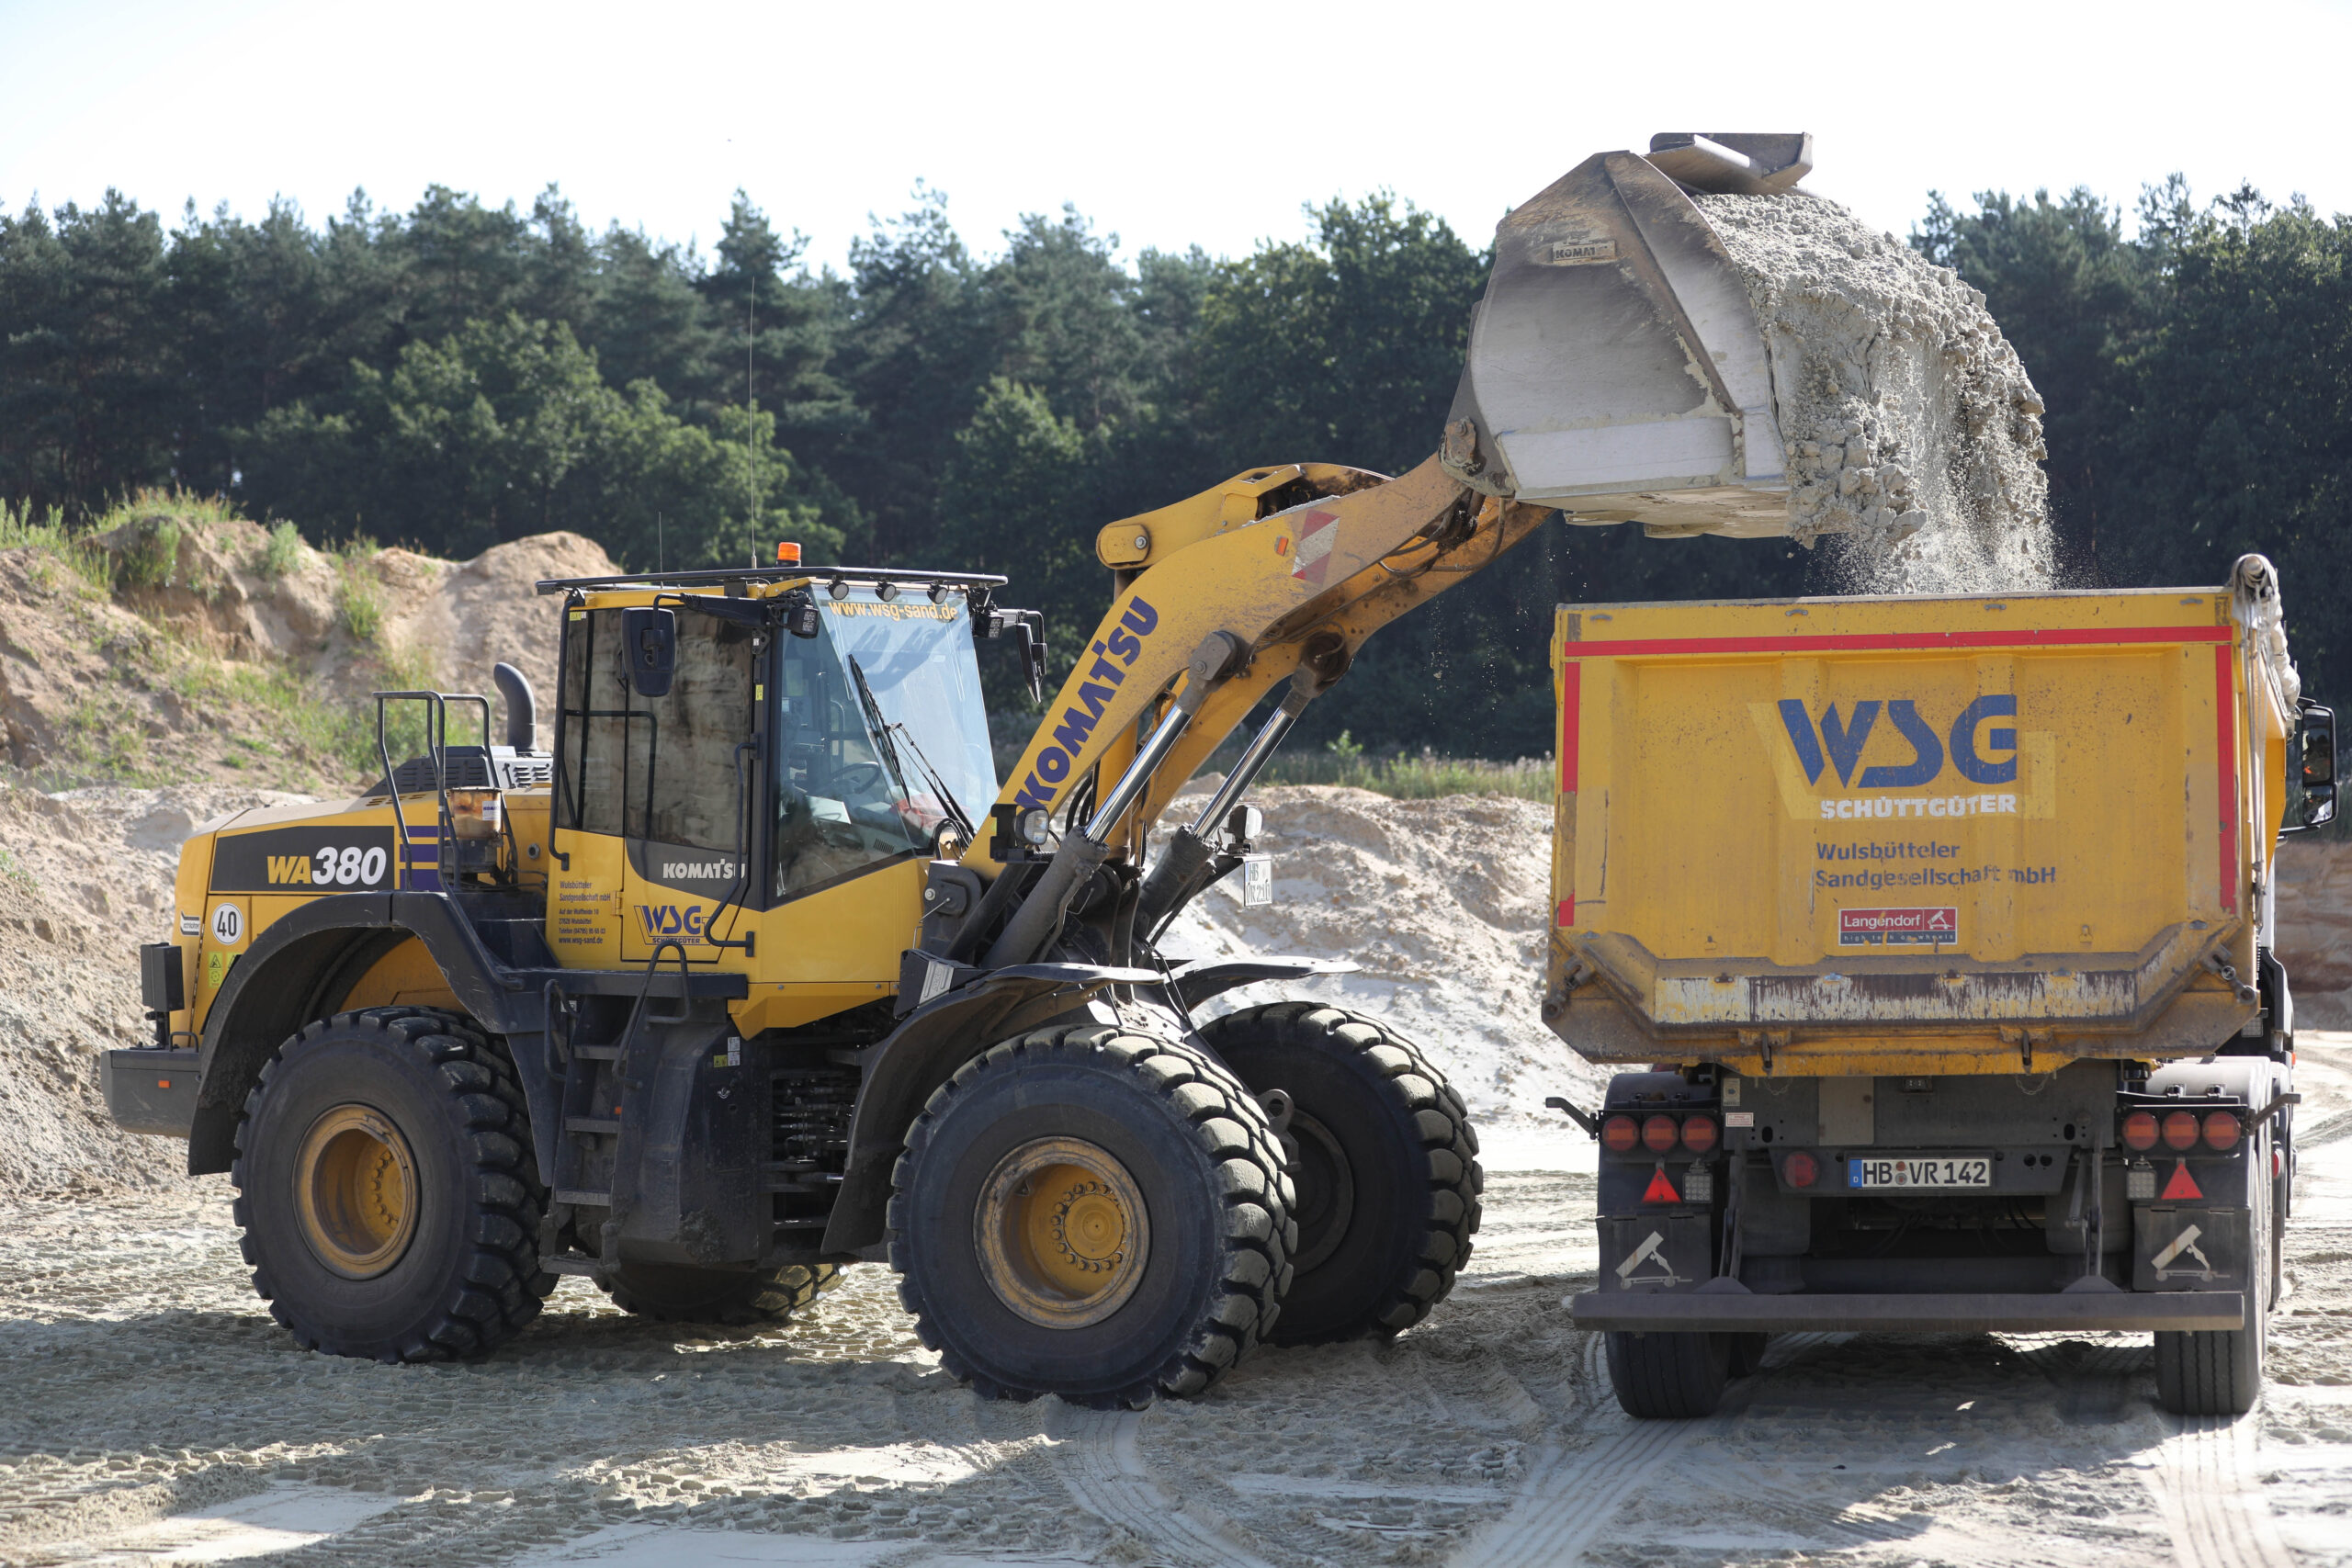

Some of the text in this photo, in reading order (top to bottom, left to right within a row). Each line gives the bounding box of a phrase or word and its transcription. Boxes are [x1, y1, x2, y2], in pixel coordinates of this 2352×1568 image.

[828, 600, 958, 622] www.wsg-sand.de
[1014, 595, 1159, 810] KOMATSU
[1777, 694, 2017, 789] WSG
[1815, 841, 1961, 861] Wulsbütteler
[266, 846, 387, 885] WA380
[1249, 863, 1259, 881] HB
[1815, 867, 2001, 890] Sandgesellschaft
[217, 910, 237, 937] 40
[642, 905, 701, 934] WSG
[1844, 914, 1921, 930] Langendorf
[1863, 1162, 1893, 1185] HB
[1909, 1162, 1939, 1185] VR
[1943, 1162, 1986, 1184] 142
